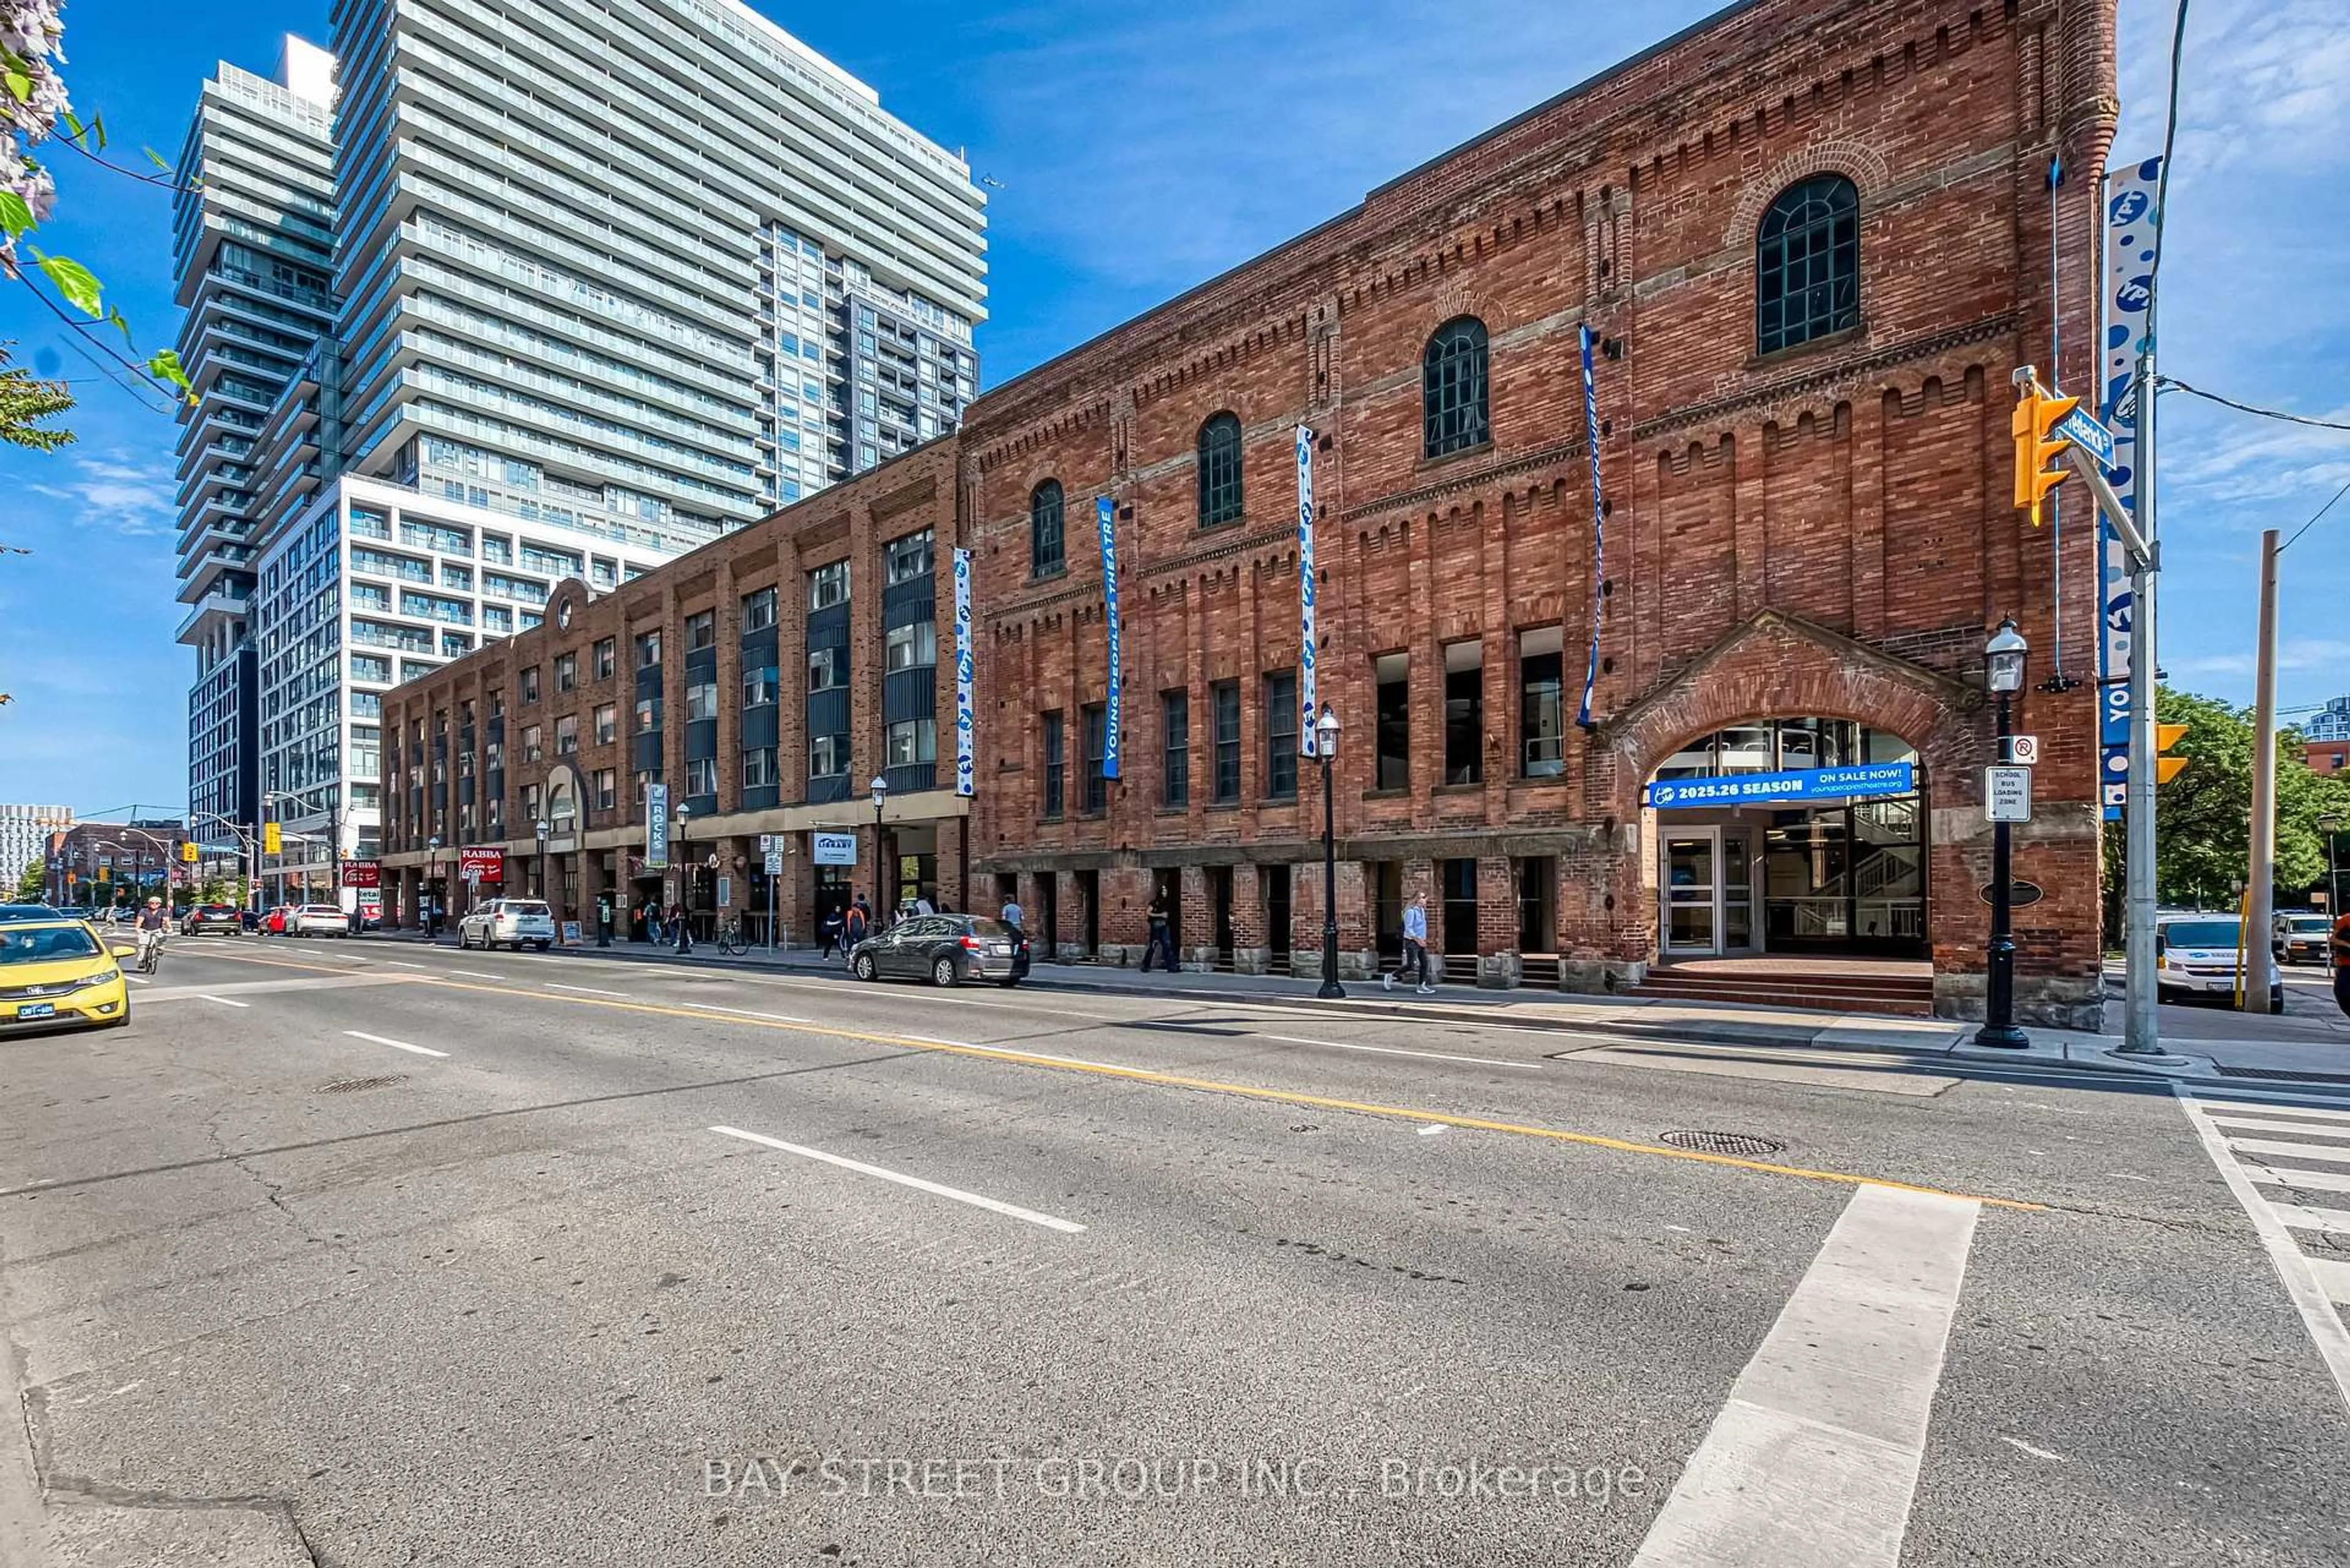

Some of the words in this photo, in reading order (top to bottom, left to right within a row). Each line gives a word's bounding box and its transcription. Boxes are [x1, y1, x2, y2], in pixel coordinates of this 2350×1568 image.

[2065, 415, 2104, 454] rederick
[1102, 510, 1116, 599] THEATRE
[1110, 601, 1120, 688] PEOPLE'S
[1107, 691, 1119, 760] YOUNG
[1679, 784, 1739, 799] 2025.26
[1743, 780, 1803, 794] SEASON
[1820, 774, 1836, 783] ON
[1839, 771, 1866, 782] SALE
[1870, 769, 1902, 780] NOW!
[653, 805, 663, 849] ROCKS
[463, 850, 501, 859] RABBA
